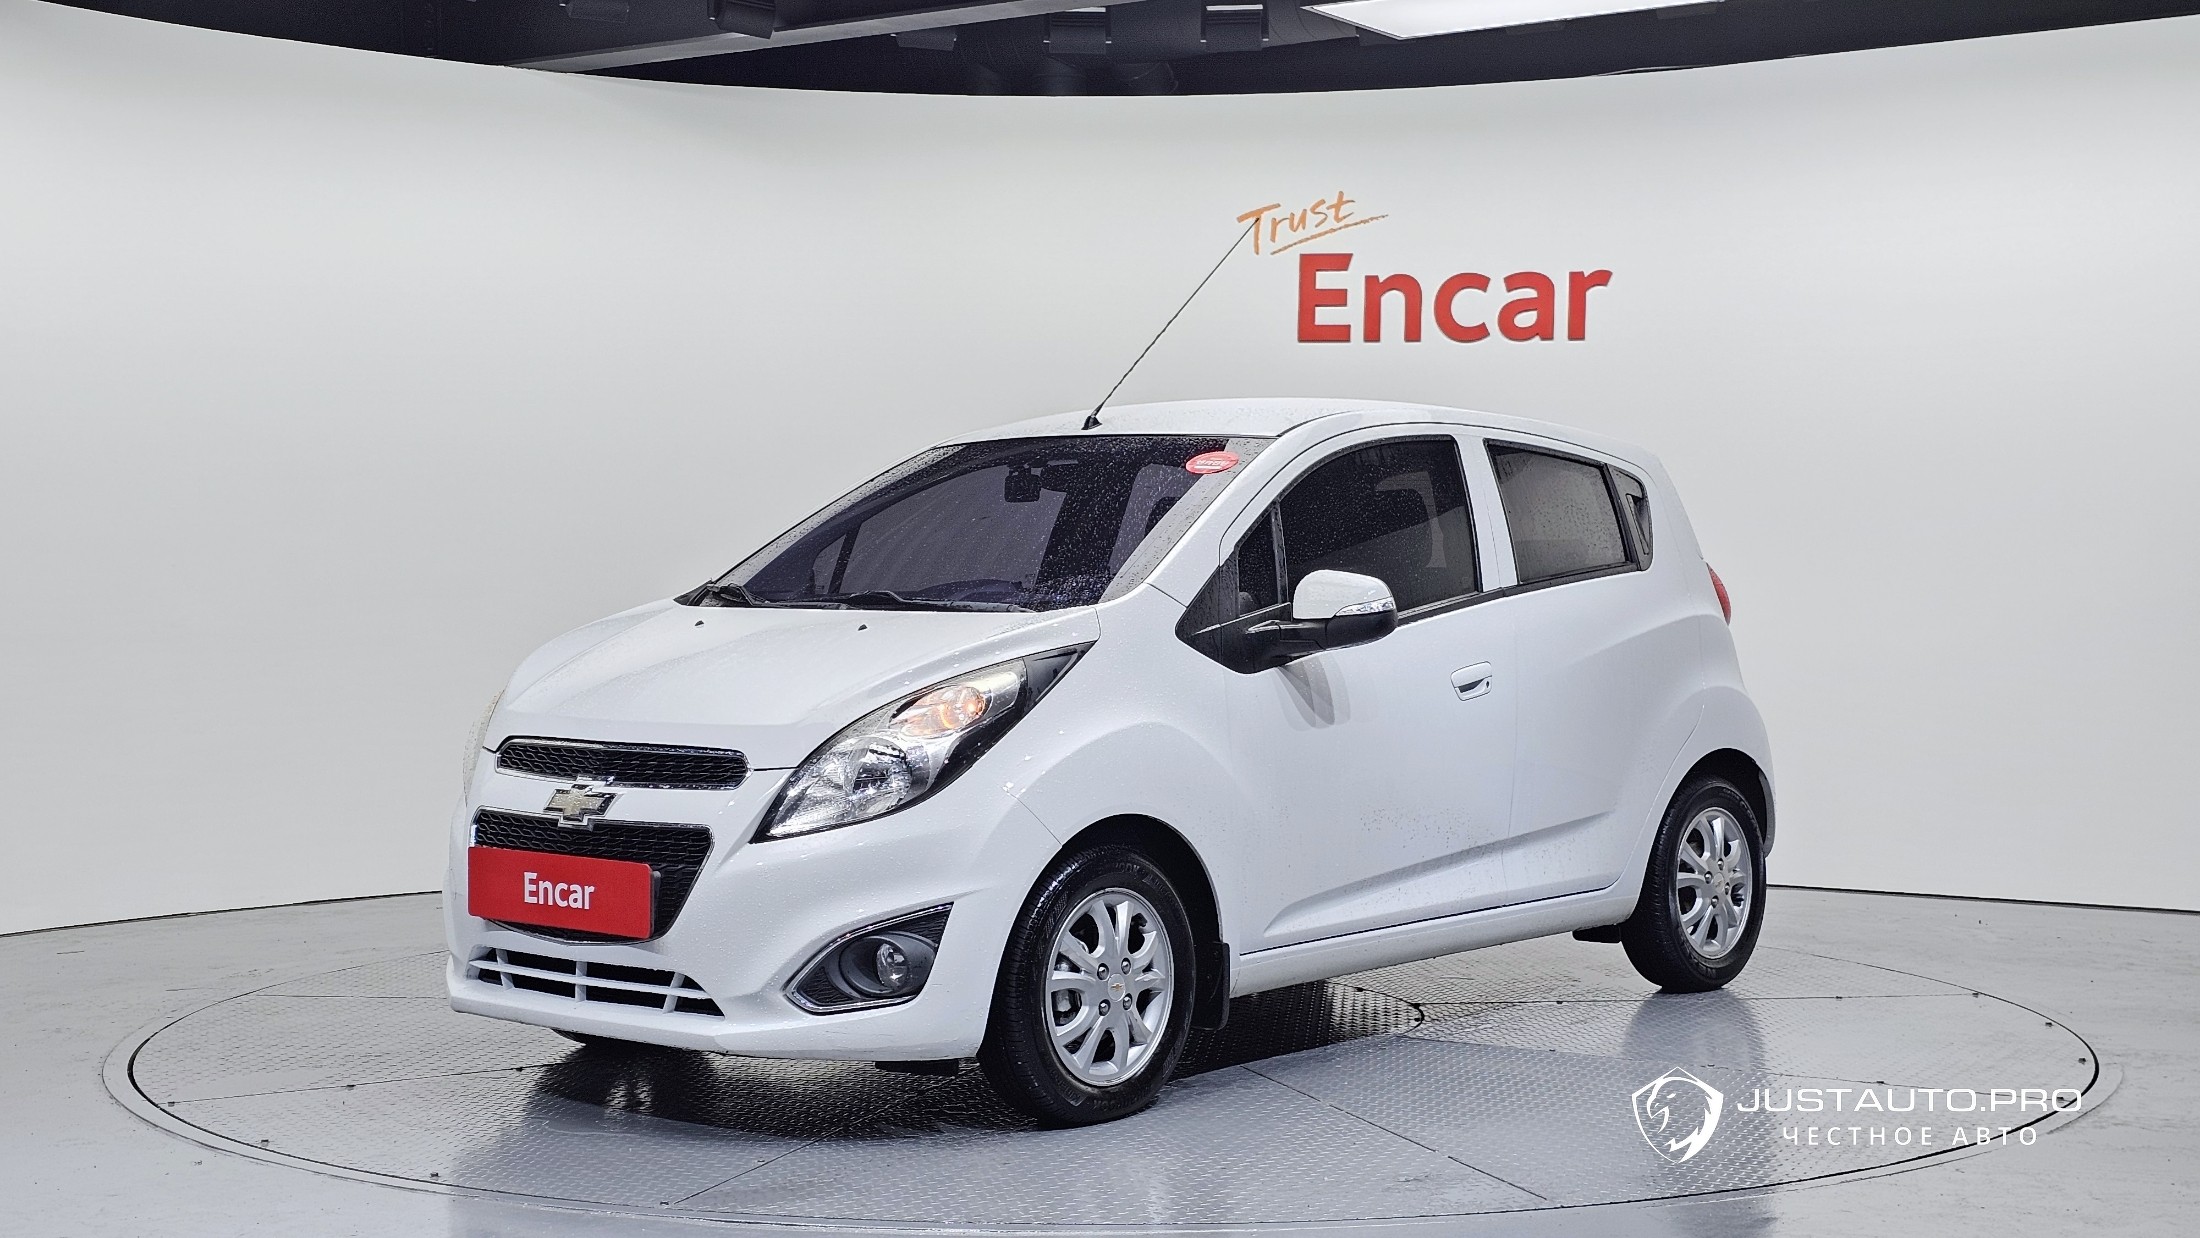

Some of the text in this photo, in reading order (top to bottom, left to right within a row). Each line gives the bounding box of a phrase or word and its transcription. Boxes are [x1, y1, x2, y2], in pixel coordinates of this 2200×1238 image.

[1237, 190, 1356, 255] Trust
[1297, 253, 1613, 343] Encar
[523, 871, 595, 910] Encar
